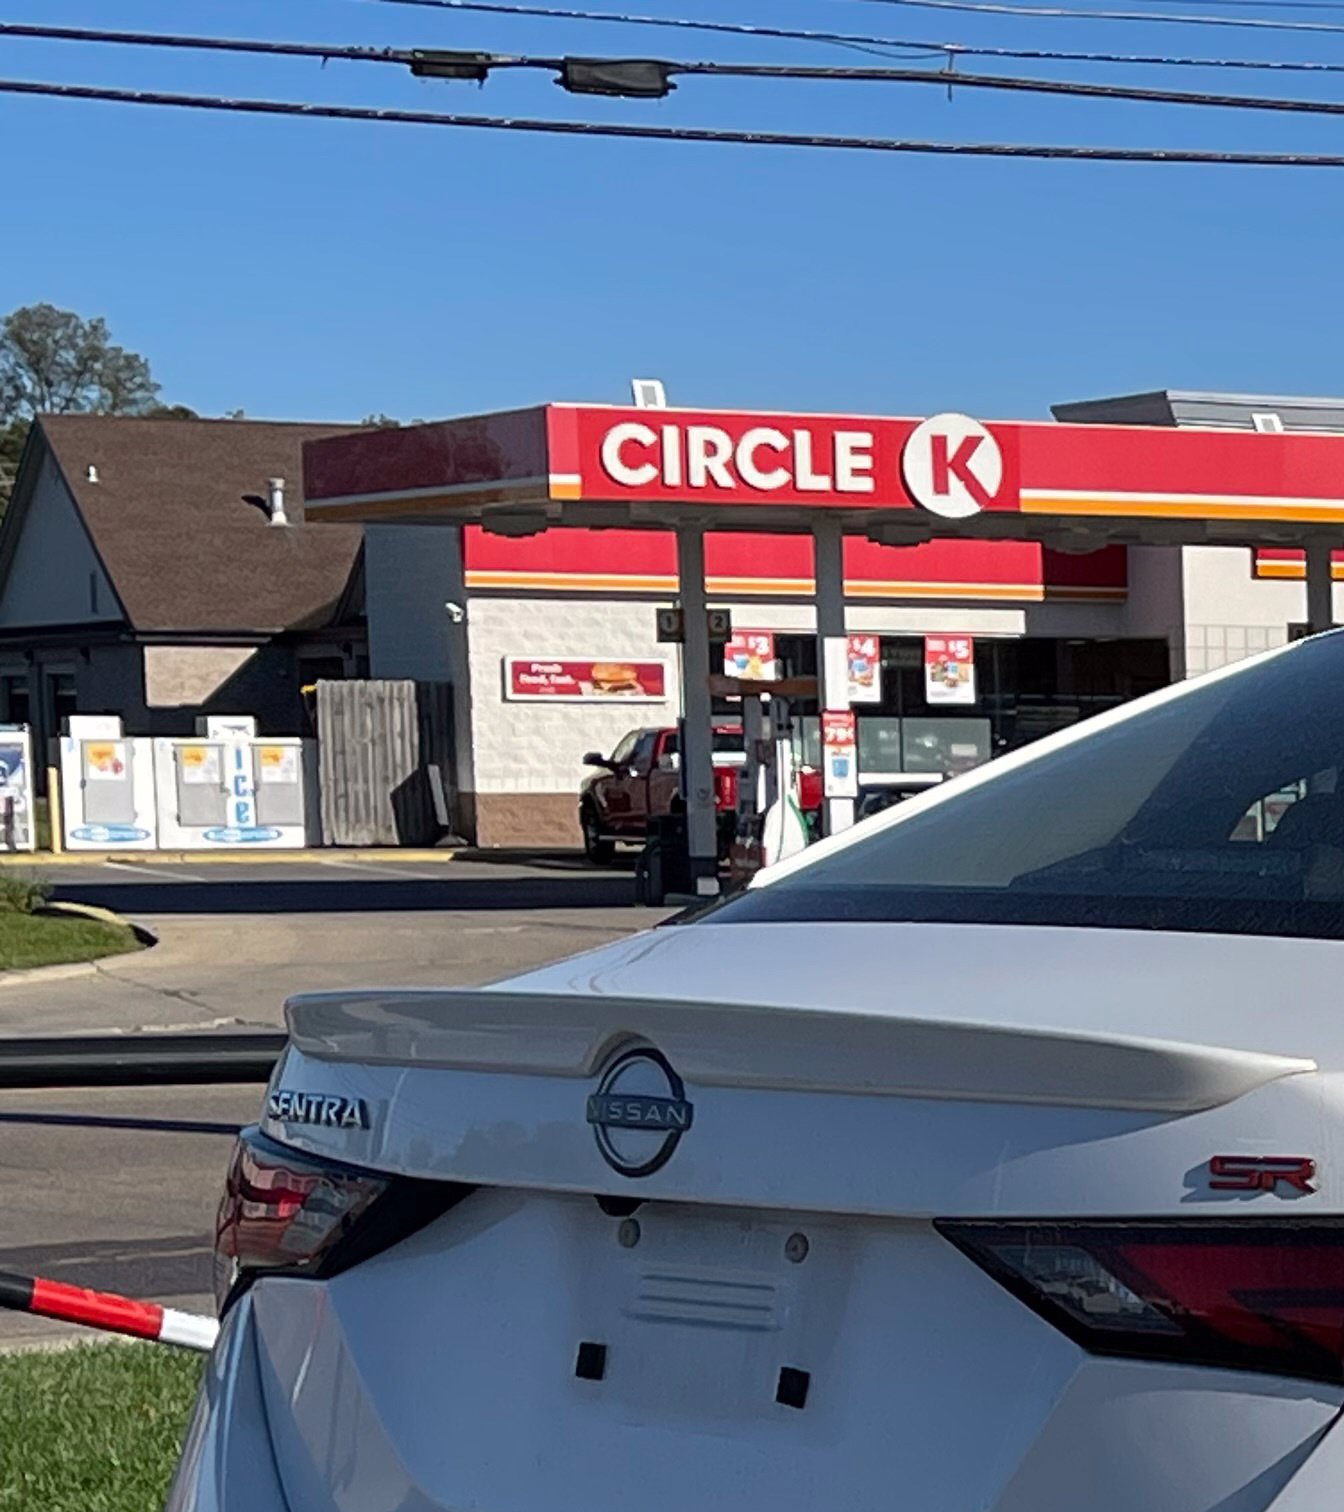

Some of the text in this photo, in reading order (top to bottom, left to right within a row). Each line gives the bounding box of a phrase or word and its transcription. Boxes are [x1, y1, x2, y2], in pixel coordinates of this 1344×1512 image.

[602, 422, 996, 511] CIRCLE K
[268, 1089, 363, 1127] SENTRA
[1209, 1155, 1318, 1195] SR
